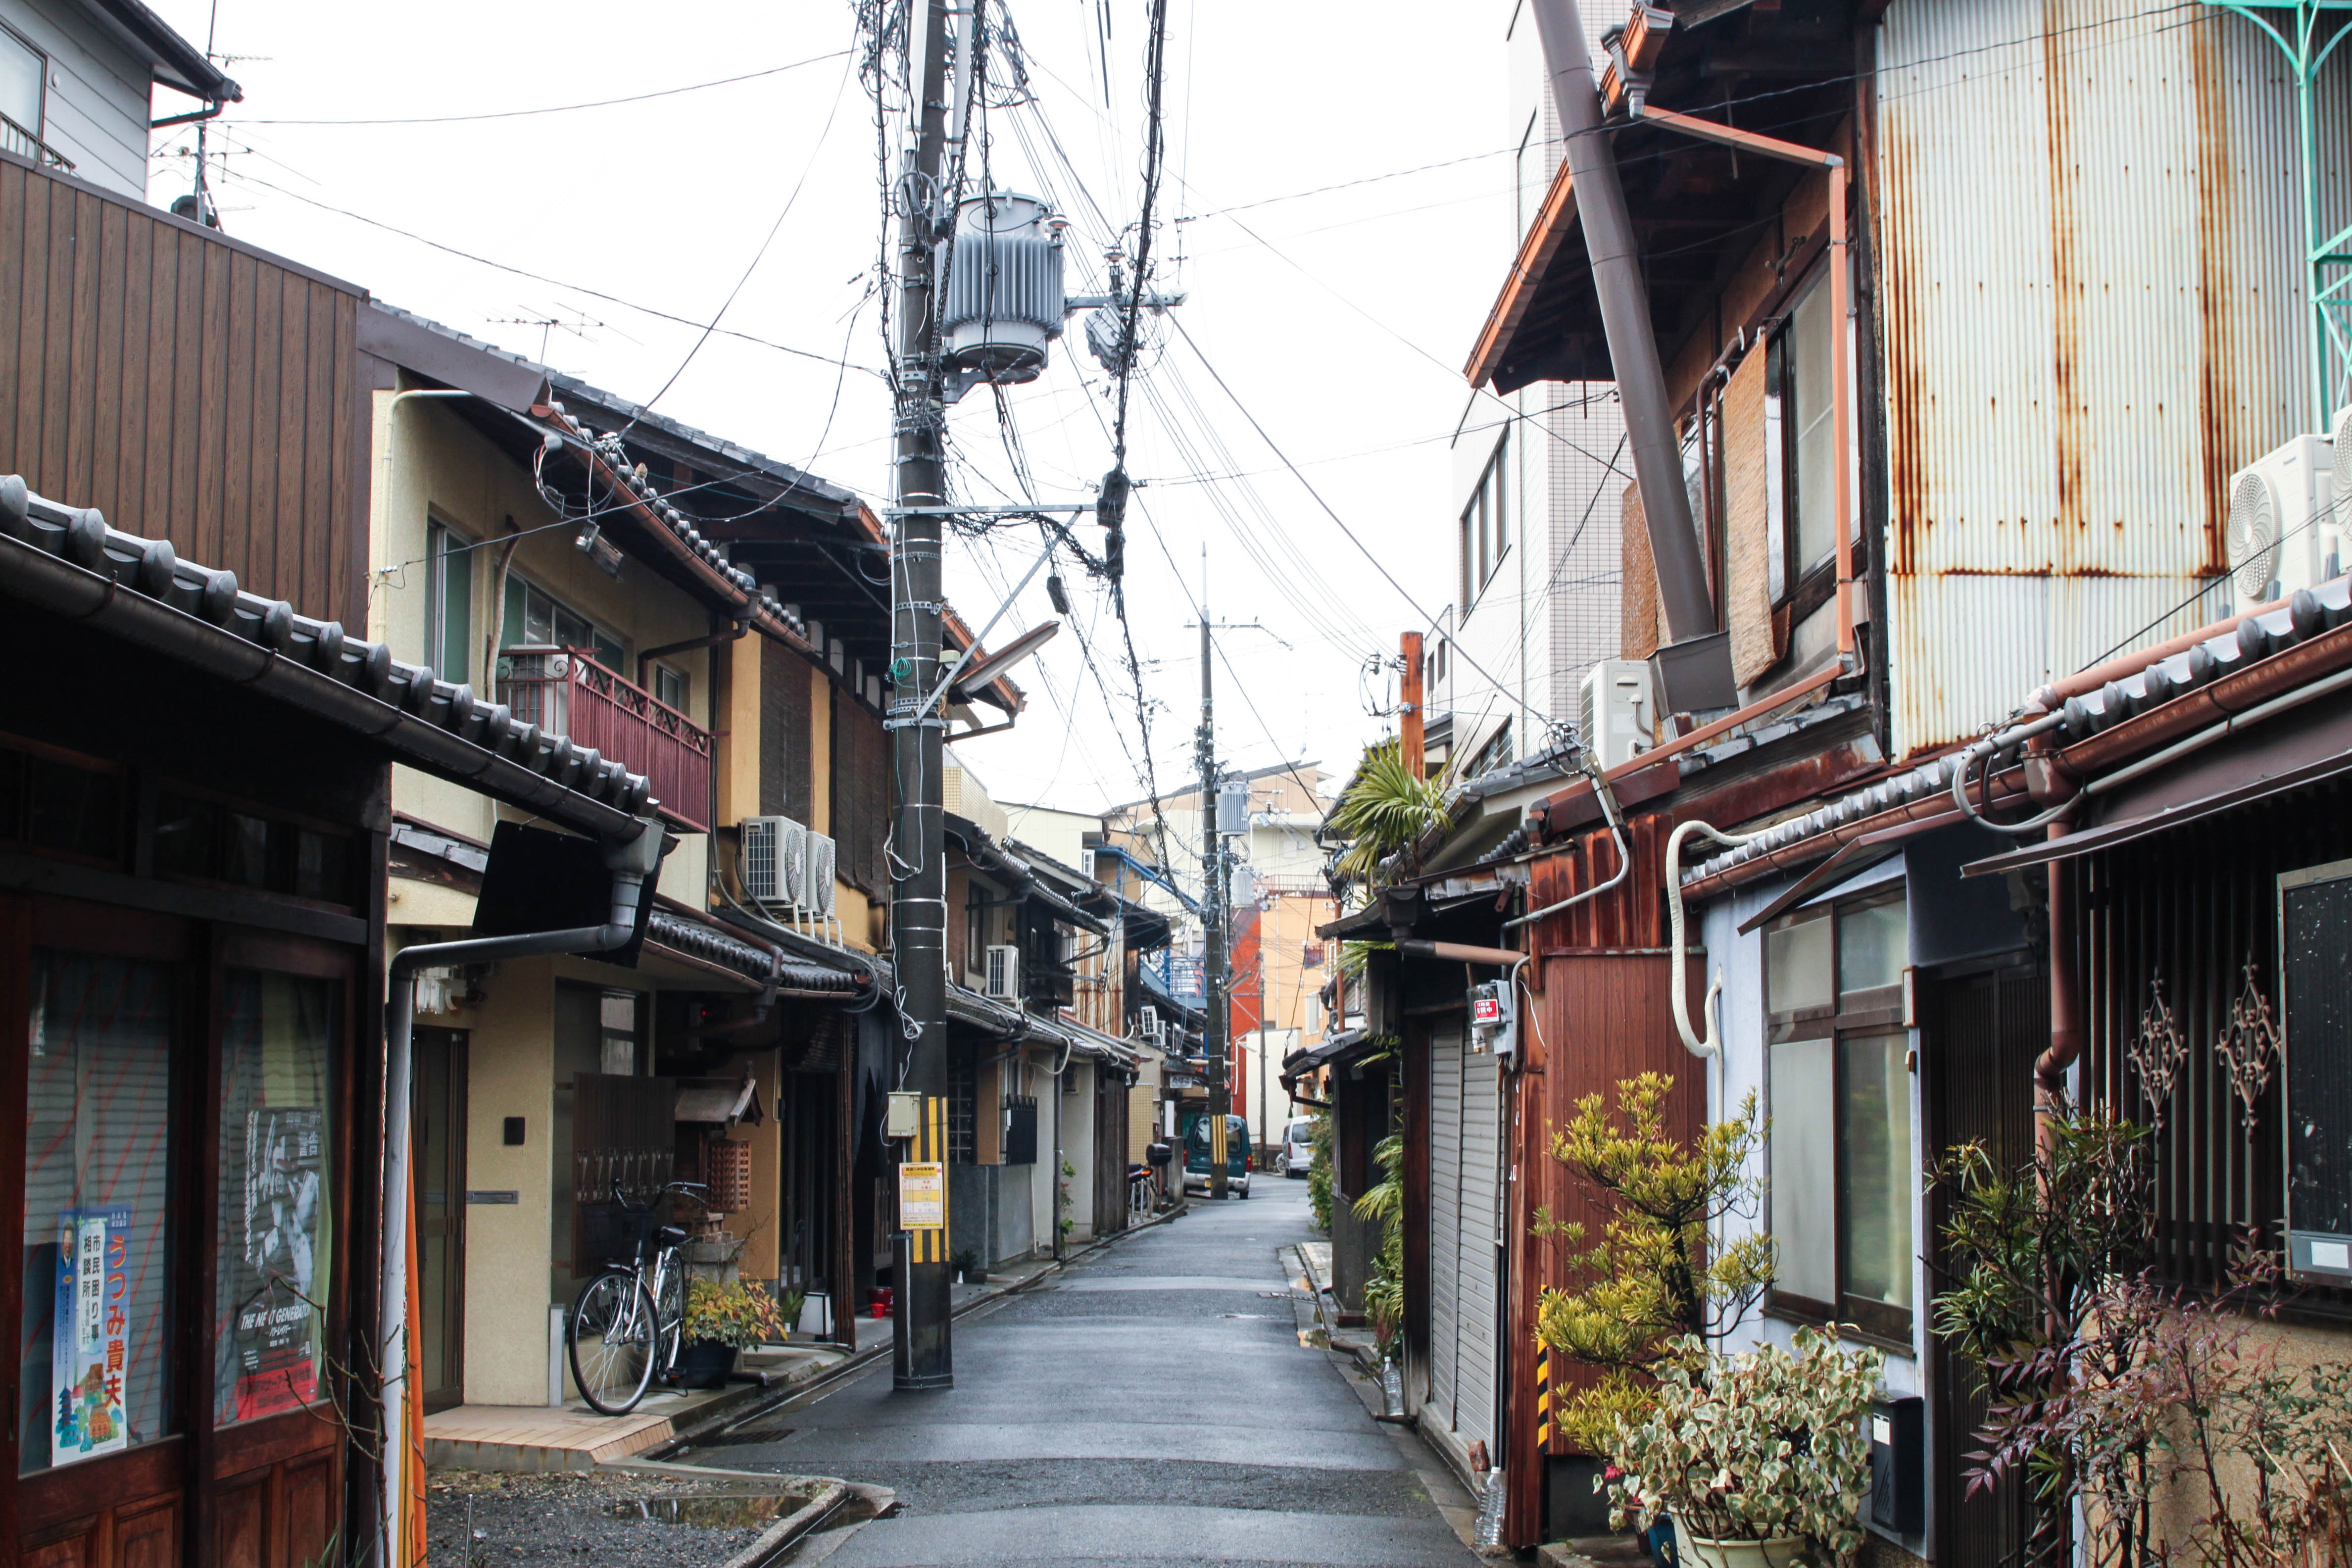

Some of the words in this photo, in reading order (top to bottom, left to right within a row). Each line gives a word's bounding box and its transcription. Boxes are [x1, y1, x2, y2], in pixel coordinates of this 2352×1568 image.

[1111, 267, 1119, 276] N
[82, 1235, 92, 1298] 相談所
[91, 1235, 101, 1341] 市民困り事
[103, 1234, 127, 1409] うつみ貴夫
[241, 1313, 256, 1330] THE
